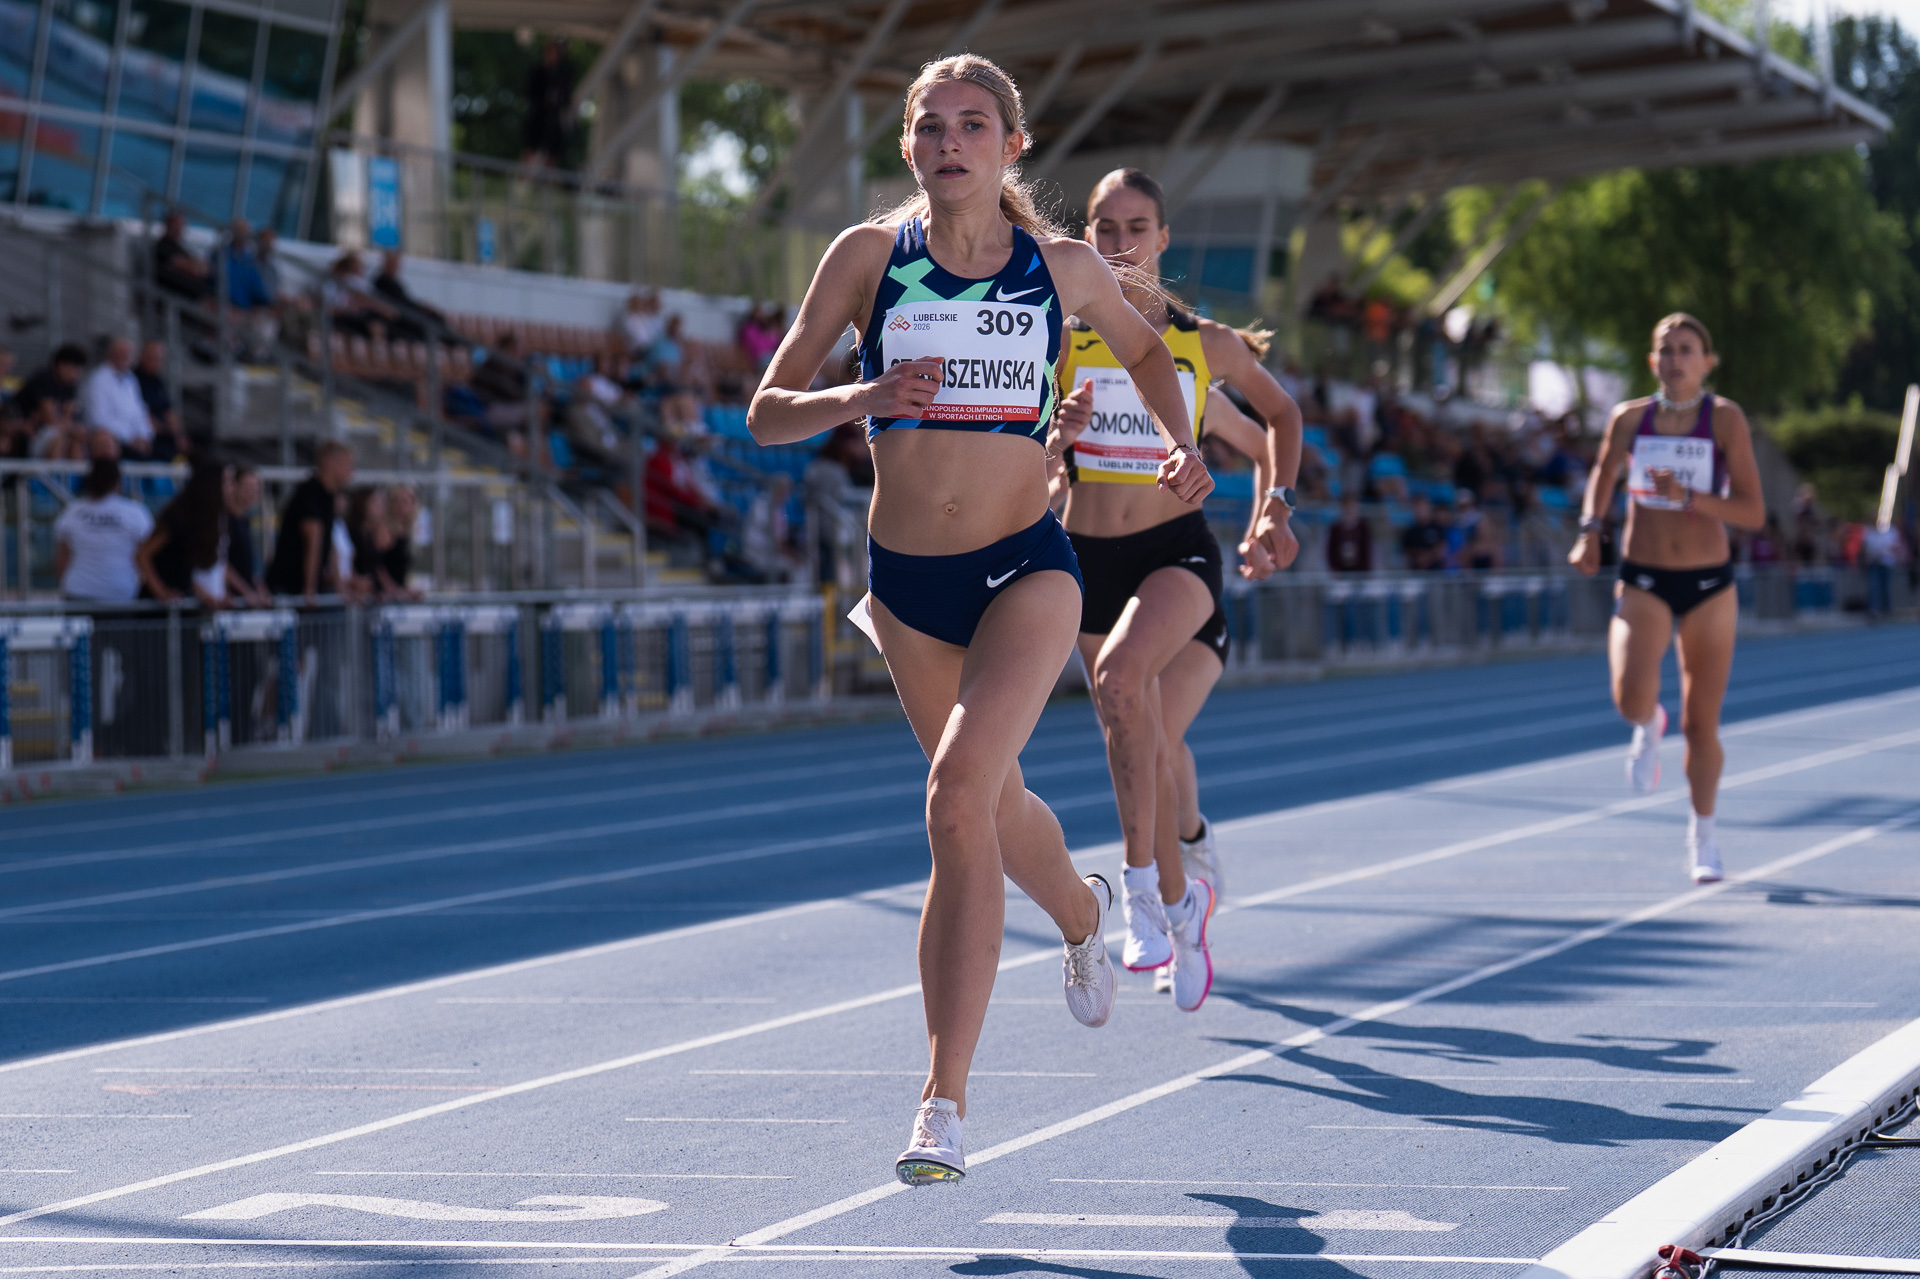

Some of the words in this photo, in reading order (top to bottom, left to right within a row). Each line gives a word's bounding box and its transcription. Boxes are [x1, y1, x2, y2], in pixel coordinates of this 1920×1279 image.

[913, 313, 958, 322] LUBELSKIE
[913, 323, 931, 331] 2026
[976, 309, 1034, 337] 309
[890, 357, 1035, 391] ISZEWSKA
[966, 406, 1003, 414] OLIMPIADA
[937, 412, 974, 420] SPORTACH
[975, 413, 1003, 421] LETNICH
[1098, 459, 1134, 470] LUBLIN
